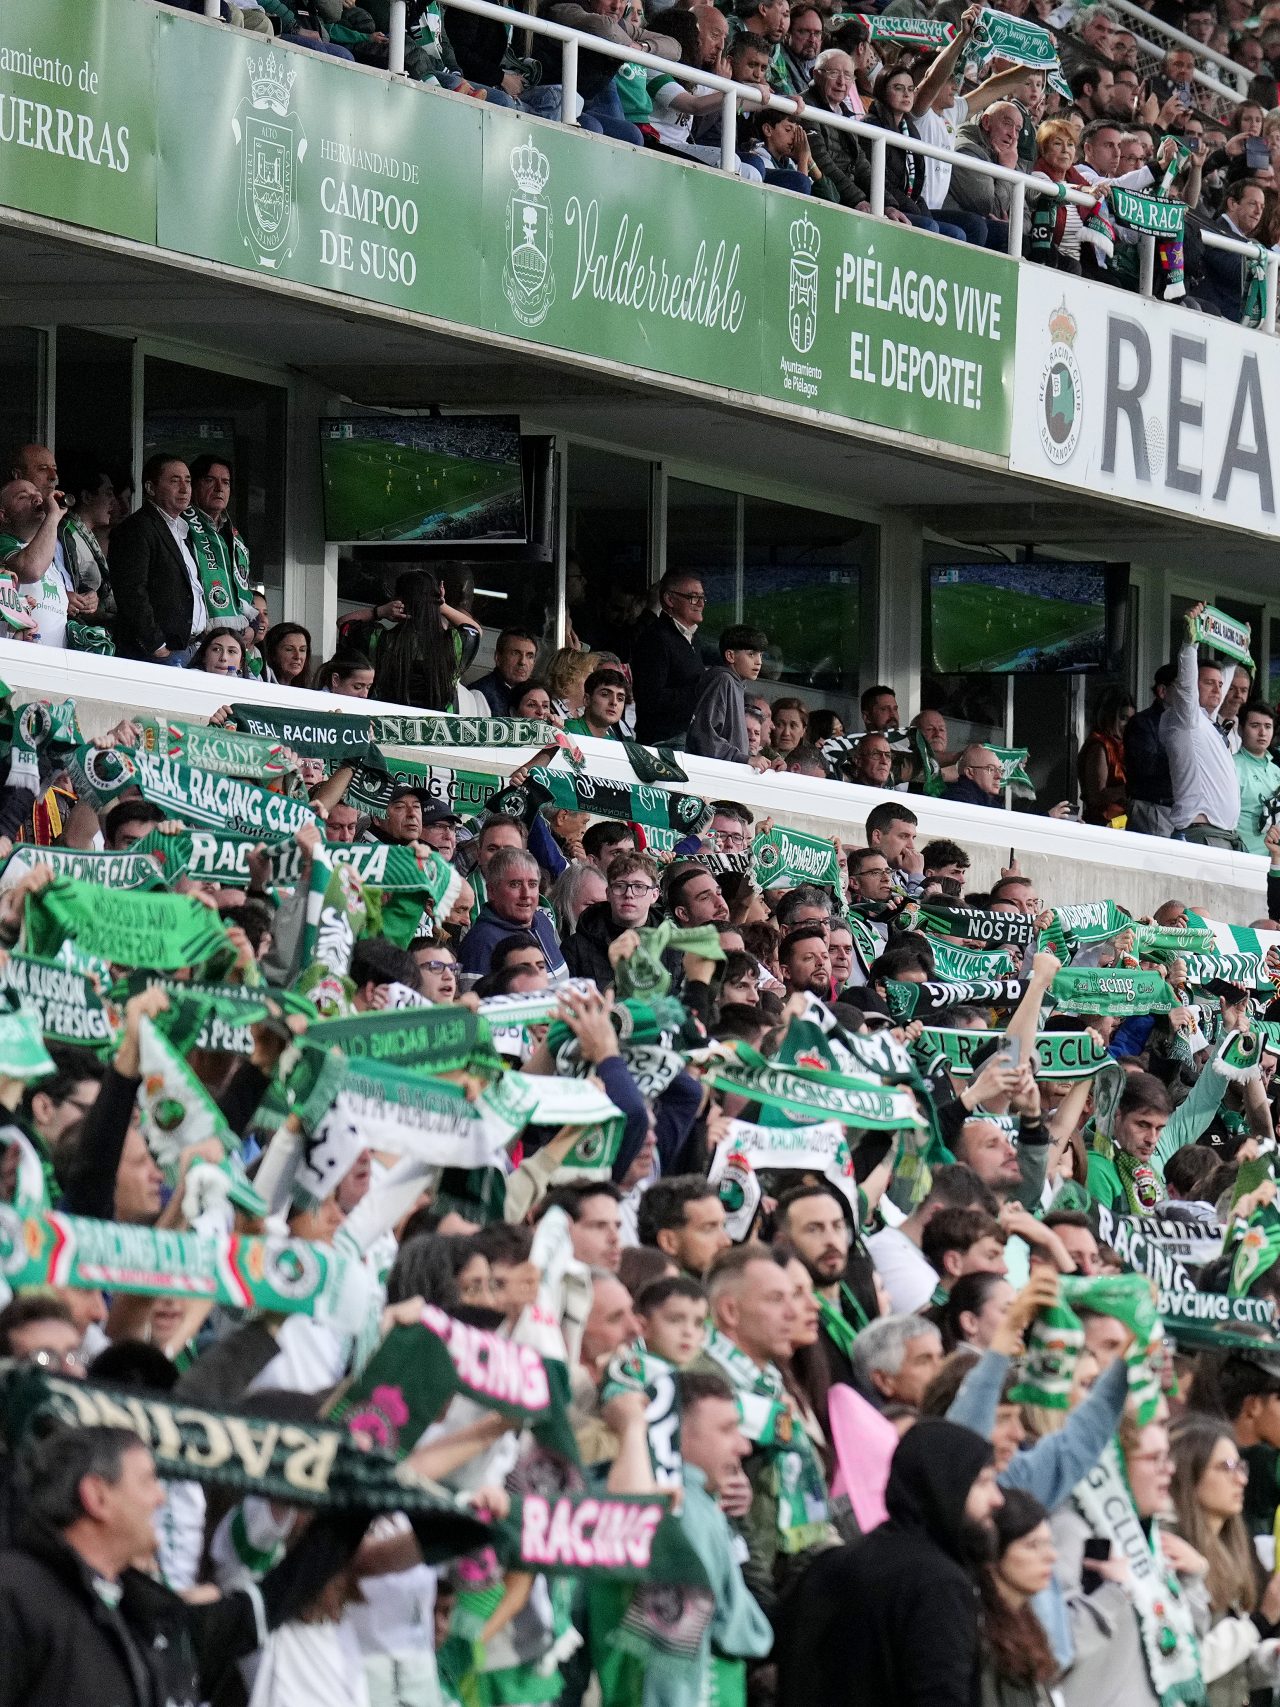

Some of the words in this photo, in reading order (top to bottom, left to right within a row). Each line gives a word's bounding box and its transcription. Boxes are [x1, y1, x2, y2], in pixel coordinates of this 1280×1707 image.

[0, 50, 72, 90] amiento
[79, 64, 98, 98] de
[261, 127, 278, 139] ALTO
[320, 138, 399, 179] HERMANDAD
[402, 162, 420, 185] DE
[320, 177, 419, 235] CAMPOO
[1117, 192, 1145, 224] UPA
[257, 227, 280, 245] FONTES
[319, 229, 354, 271] DE
[360, 239, 417, 287] SUSO
[565, 194, 747, 334] Valderredible
[834, 243, 949, 327] ¡PIÉLAGOS
[953, 284, 1002, 341] VIVE
[779, 355, 822, 382] Ayuntamiento
[849, 332, 878, 380] EL
[881, 337, 983, 410] DEPORTE!
[1049, 346, 1073, 368] RACING
[783, 374, 794, 391] de
[797, 377, 820, 400] Piélagos
[1042, 426, 1075, 460] SANTANDER
[201, 536, 219, 570] REAL
[249, 719, 281, 739] REAL
[283, 724, 337, 745] RACING
[187, 733, 264, 767] RACING
[136, 750, 188, 801] REAL
[189, 769, 263, 825] RACING
[265, 789, 319, 836] CLUB
[446, 781, 495, 804] CLUB
[781, 838, 831, 877] RACINGUISTA
[967, 918, 1005, 940] NOS
[1090, 967, 1134, 1001] Racing
[845, 1087, 894, 1115] CLUB
[1098, 1202, 1197, 1293] RACING
[520, 1495, 663, 1569] RACING
[1102, 1498, 1151, 1578] CLUB
